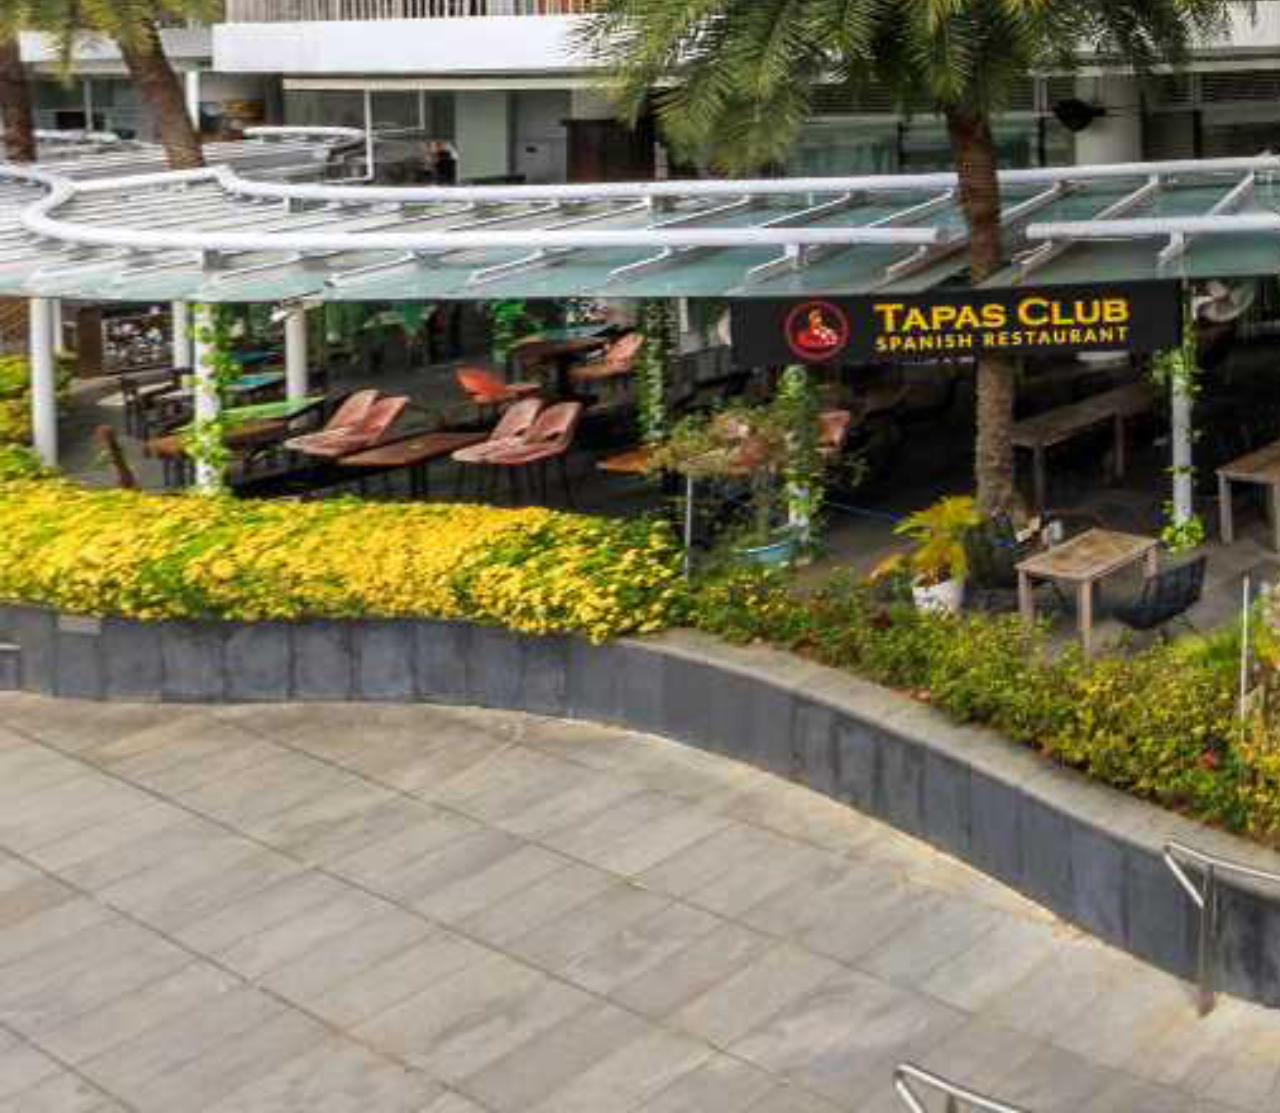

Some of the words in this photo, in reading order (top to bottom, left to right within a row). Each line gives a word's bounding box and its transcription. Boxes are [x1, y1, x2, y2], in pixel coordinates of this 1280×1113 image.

[873, 302, 1006, 333] TAPAS
[1017, 296, 1130, 326] CLUB
[873, 334, 973, 352] SPANISH
[984, 326, 1129, 346] RESTAURANT
